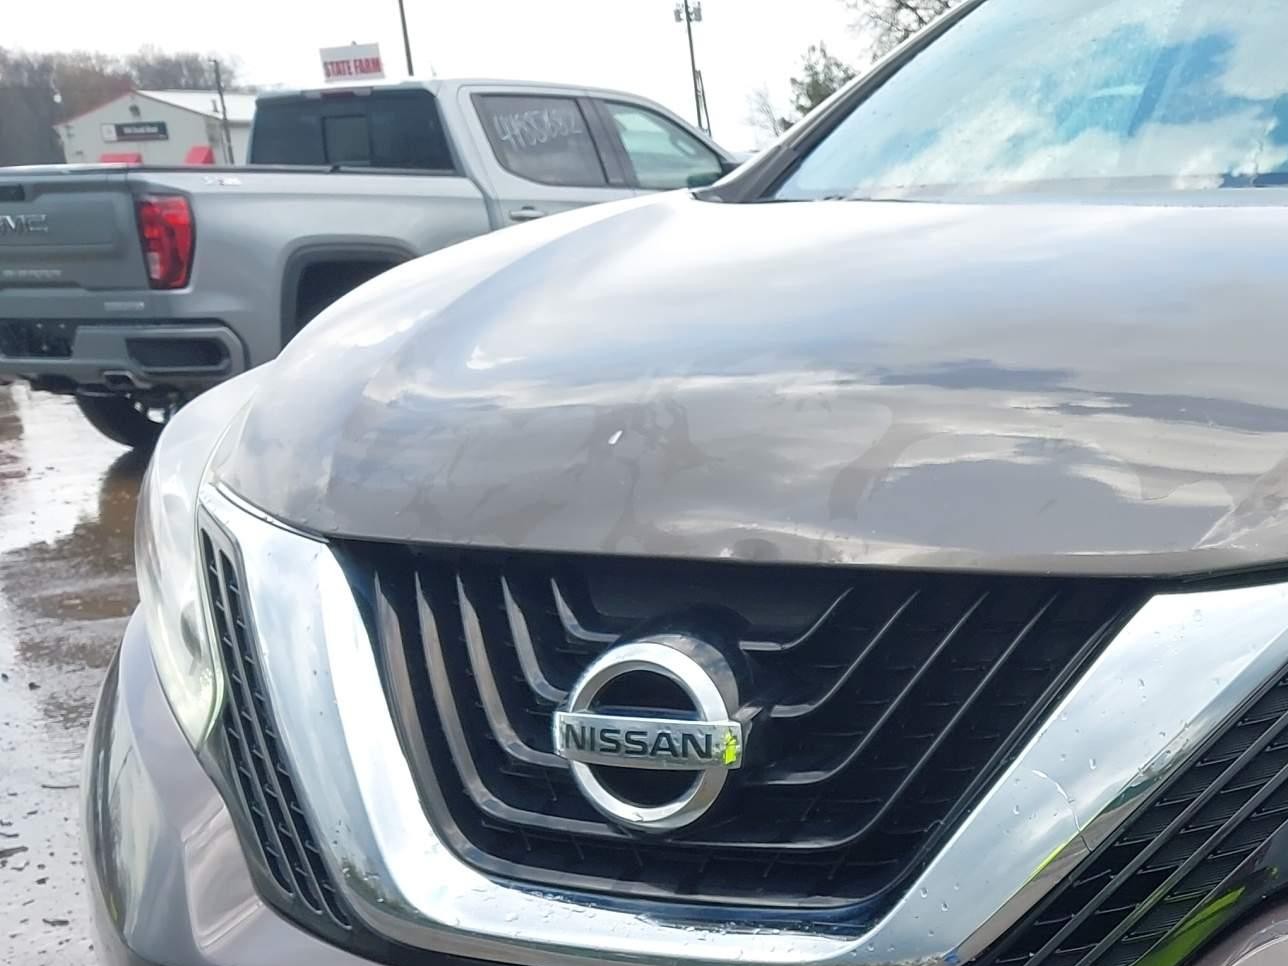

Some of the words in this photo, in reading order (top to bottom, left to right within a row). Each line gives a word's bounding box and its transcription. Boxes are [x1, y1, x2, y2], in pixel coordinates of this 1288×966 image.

[323, 60, 352, 77] STATE
[354, 57, 381, 74] FARM
[565, 723, 712, 759] NISSAN
